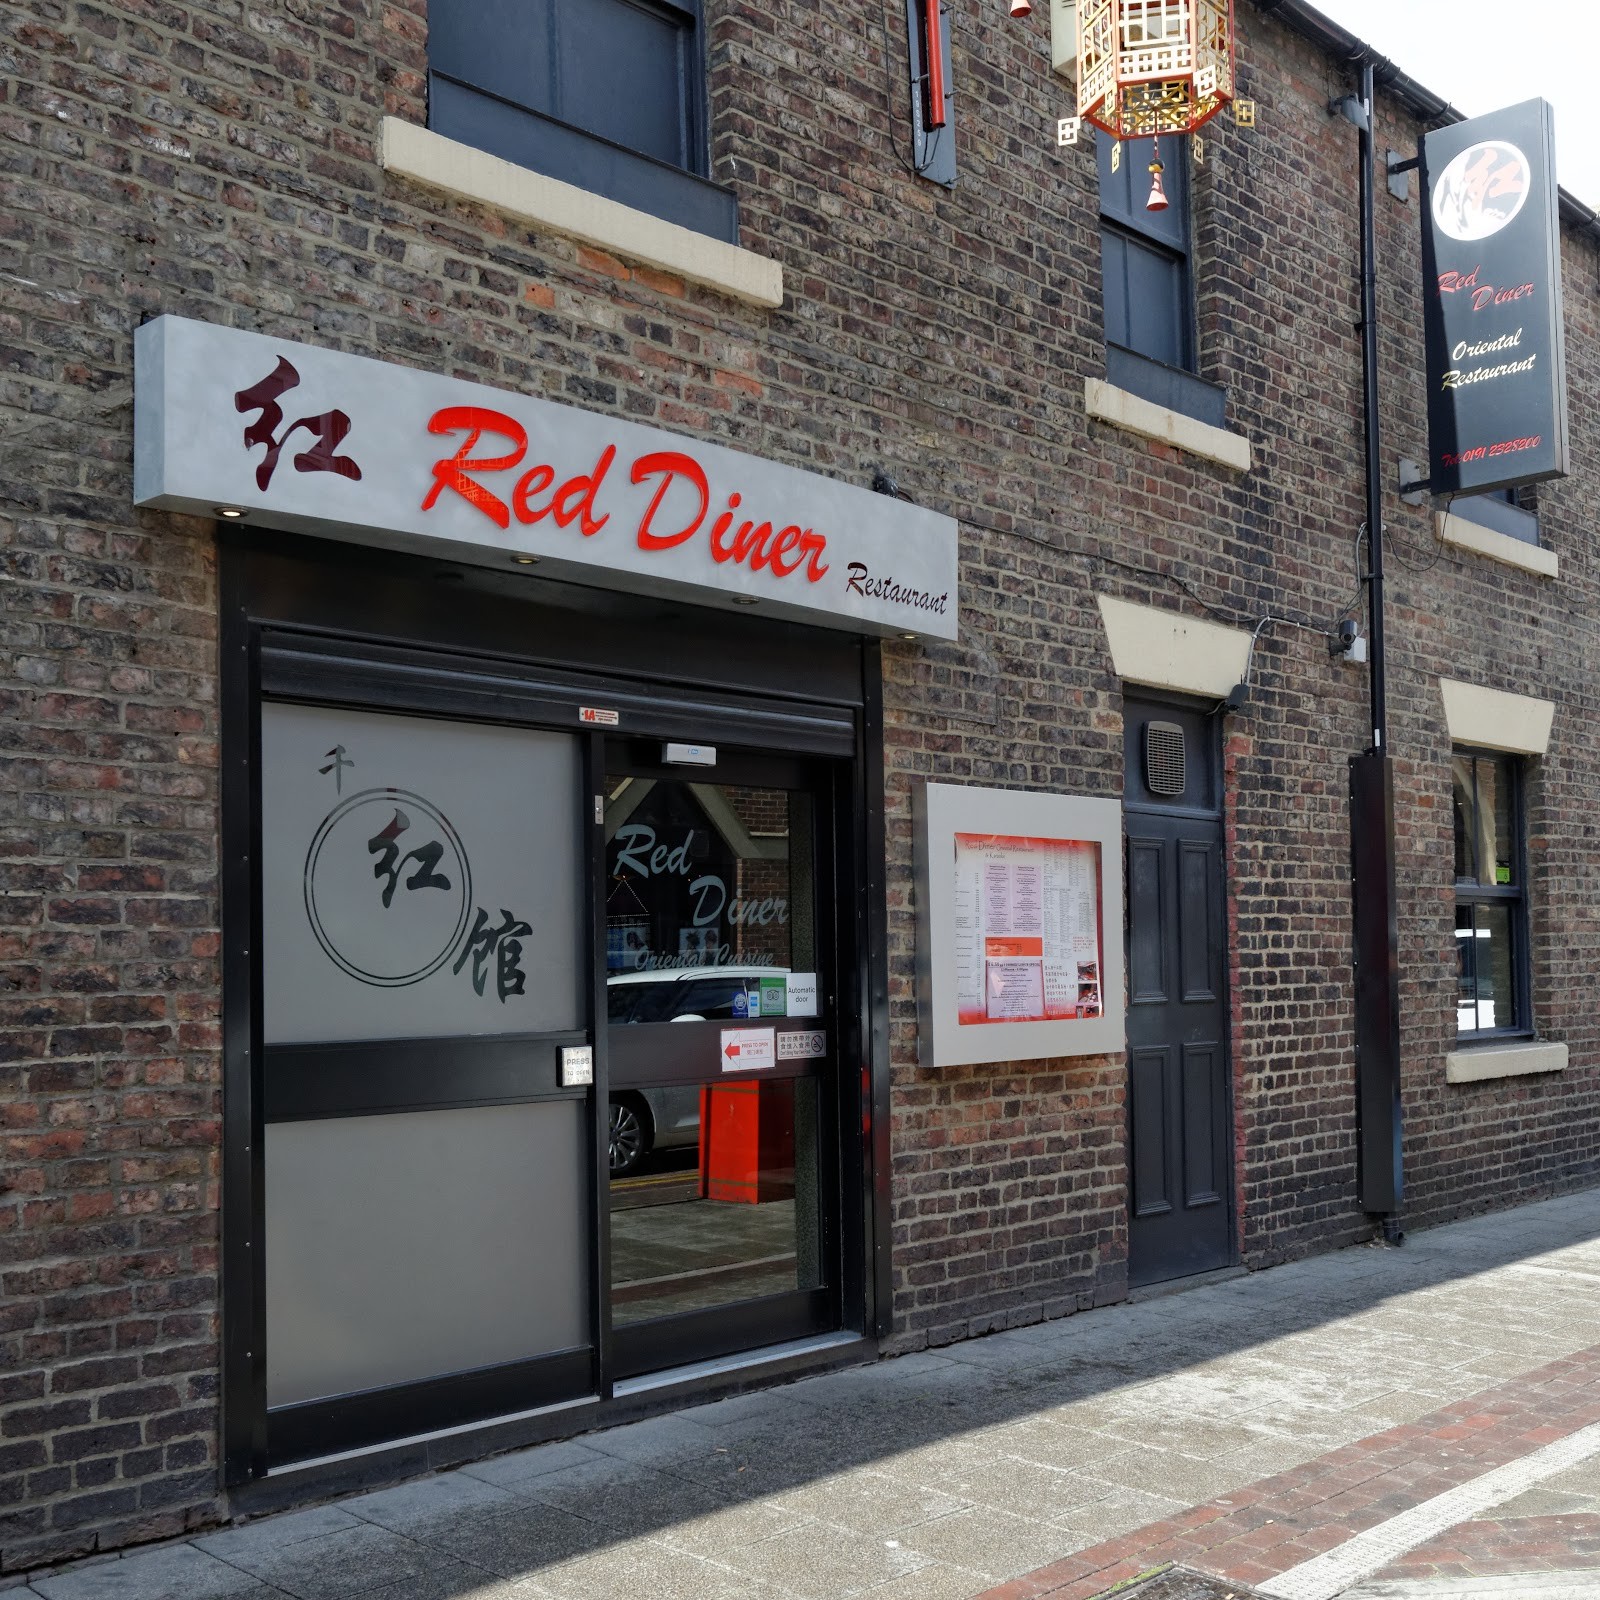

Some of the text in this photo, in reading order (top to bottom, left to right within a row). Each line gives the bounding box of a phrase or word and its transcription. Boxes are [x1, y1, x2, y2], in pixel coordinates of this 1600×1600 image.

[1436, 264, 1481, 297] Red
[1470, 282, 1535, 312] Diner
[1452, 327, 1523, 361] Oriental
[1441, 353, 1537, 392] Restaurant
[1488, 435, 1542, 457] 2328200
[421, 406, 948, 616] Red Diner Restaurant
[612, 823, 695, 879] Red
[689, 875, 790, 927] Diner
[634, 943, 774, 972] Oriental Cuisine
[566, 1057, 590, 1066] PRESS
